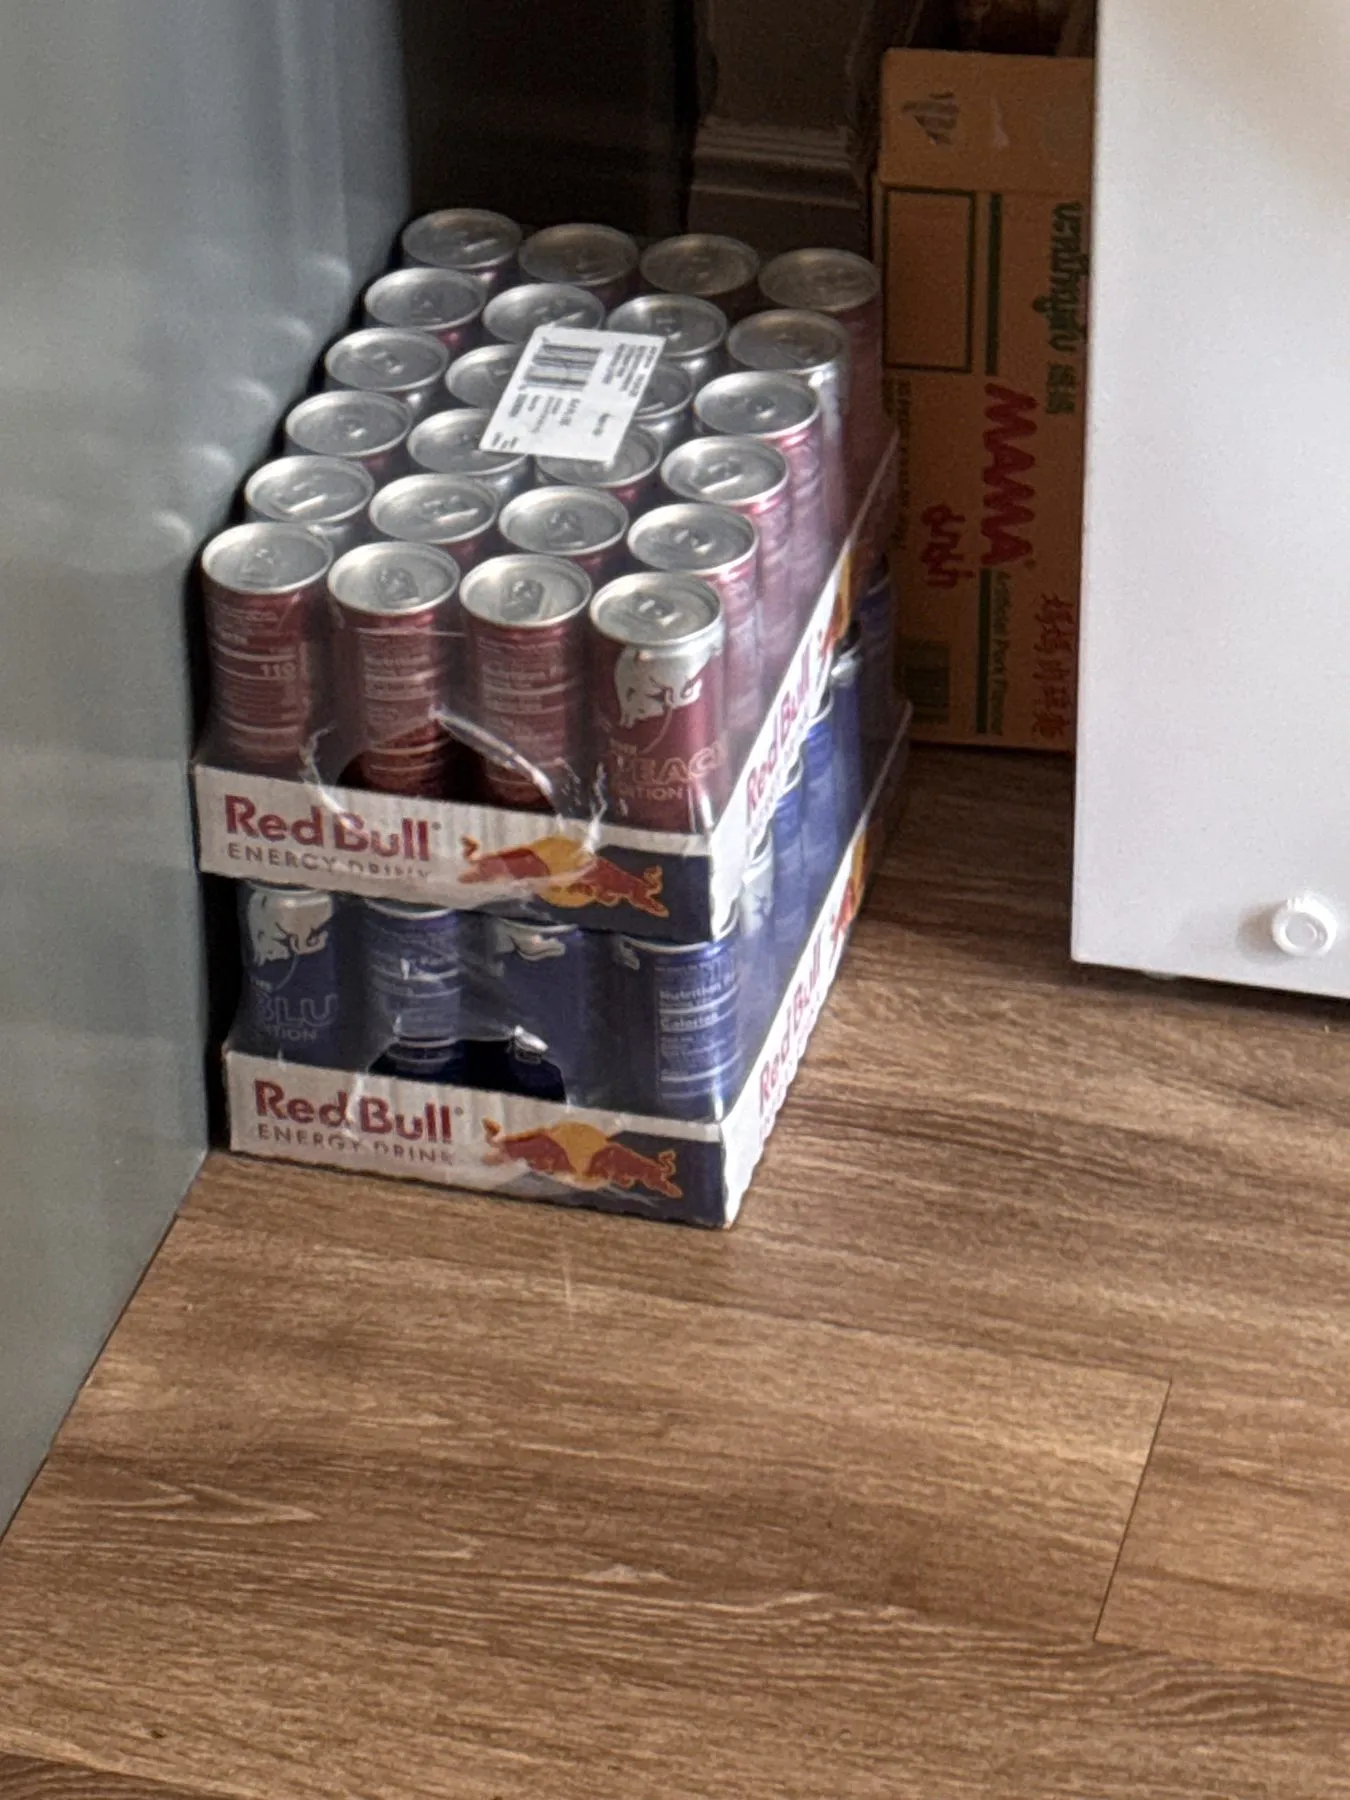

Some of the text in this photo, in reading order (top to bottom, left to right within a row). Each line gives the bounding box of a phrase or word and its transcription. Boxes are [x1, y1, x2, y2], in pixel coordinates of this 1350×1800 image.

[981, 382, 1039, 566] MAMA
[920, 504, 976, 589] มาม่า
[224, 794, 430, 862] Red Bull
[227, 841, 337, 873] ENERGY
[759, 1005, 793, 1117] Red
[254, 1079, 453, 1144] Red Bull
[257, 1123, 456, 1167] ENERGY DRINK
